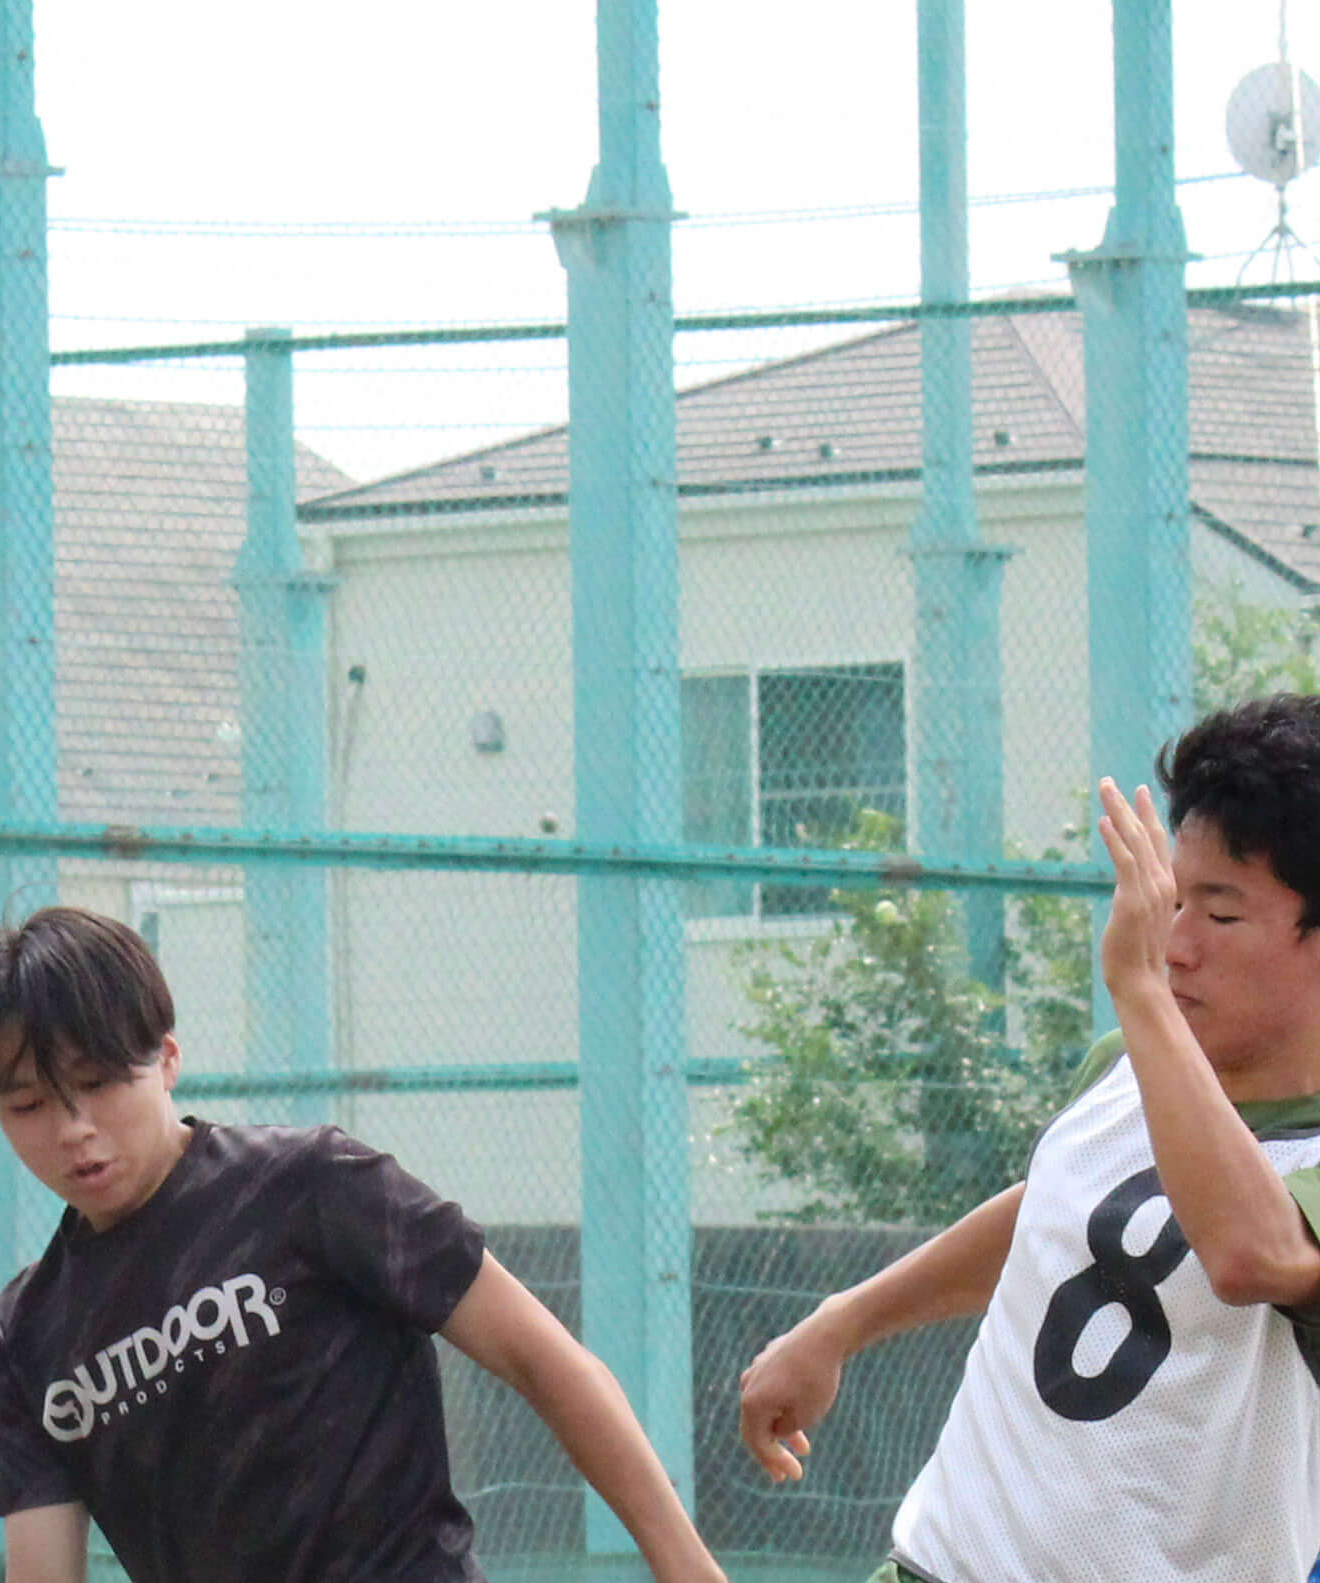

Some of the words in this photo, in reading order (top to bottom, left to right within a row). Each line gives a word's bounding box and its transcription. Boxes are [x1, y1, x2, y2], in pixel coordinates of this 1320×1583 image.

[42, 1273, 281, 1442] OUTDOOR
[1034, 1166, 1191, 1421] 8
[101, 1341, 225, 1425] PRODCTS
